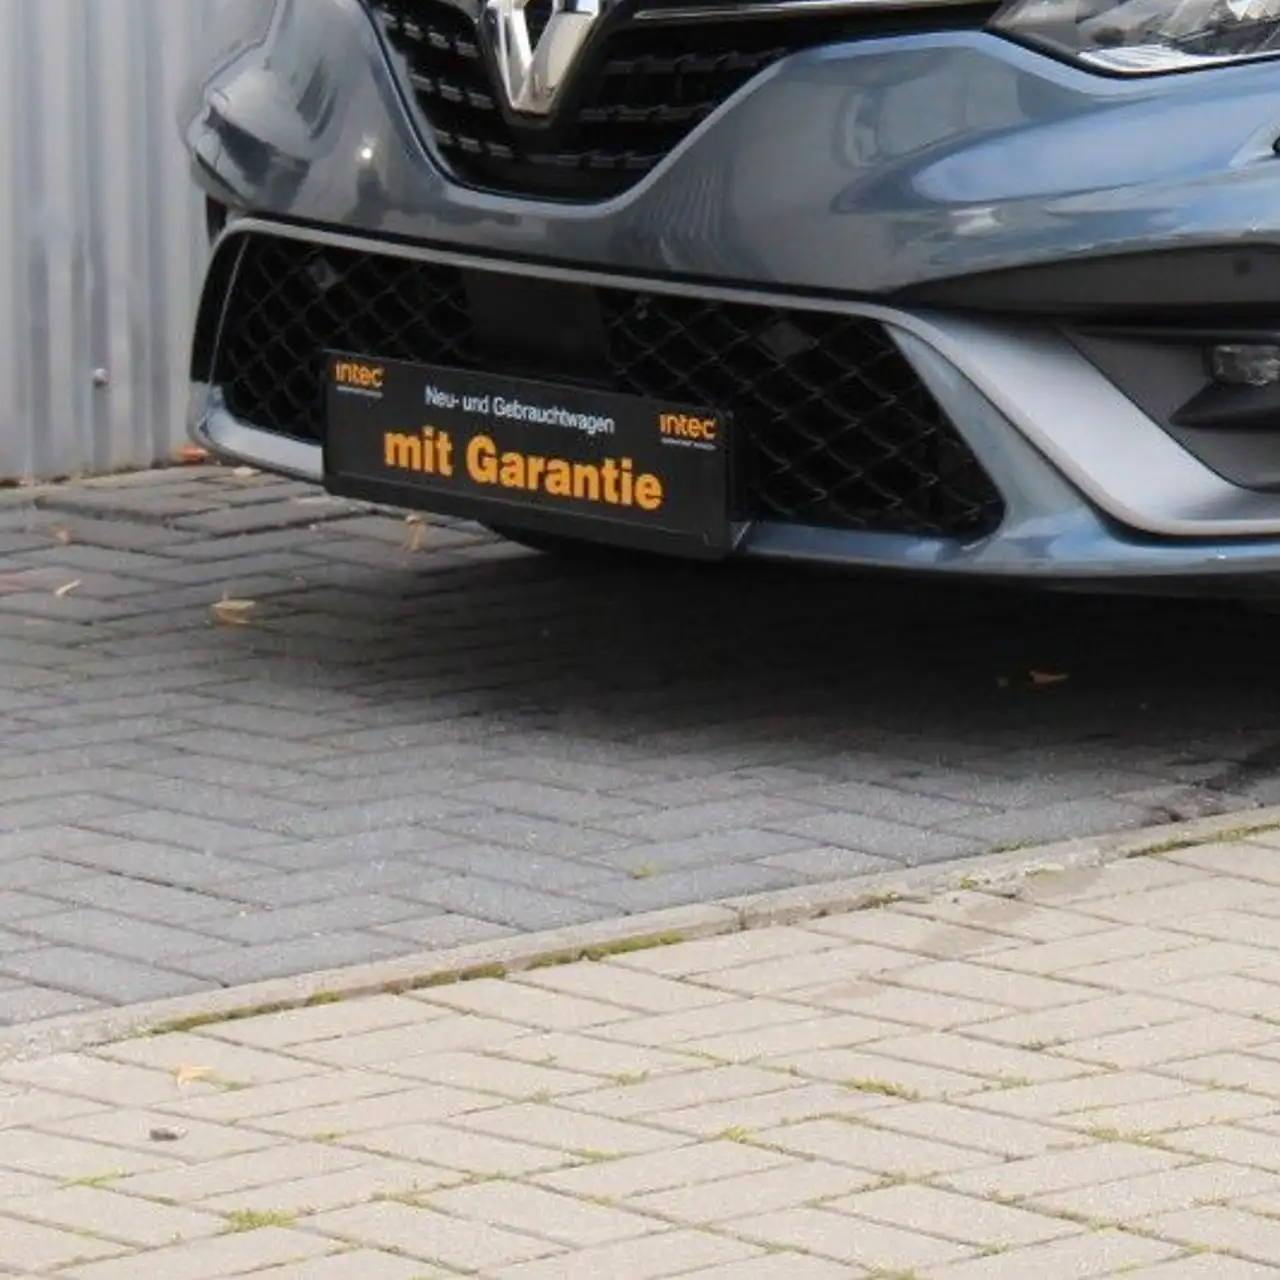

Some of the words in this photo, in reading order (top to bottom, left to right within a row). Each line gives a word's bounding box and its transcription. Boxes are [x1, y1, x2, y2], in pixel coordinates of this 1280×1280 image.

[336, 360, 384, 388] intec
[425, 384, 459, 408] Neu-
[463, 395, 489, 414] und
[493, 396, 615, 435] Gebrauchtwagen
[660, 413, 717, 440] intec
[384, 424, 453, 476] mit
[466, 434, 663, 510] Garantie
